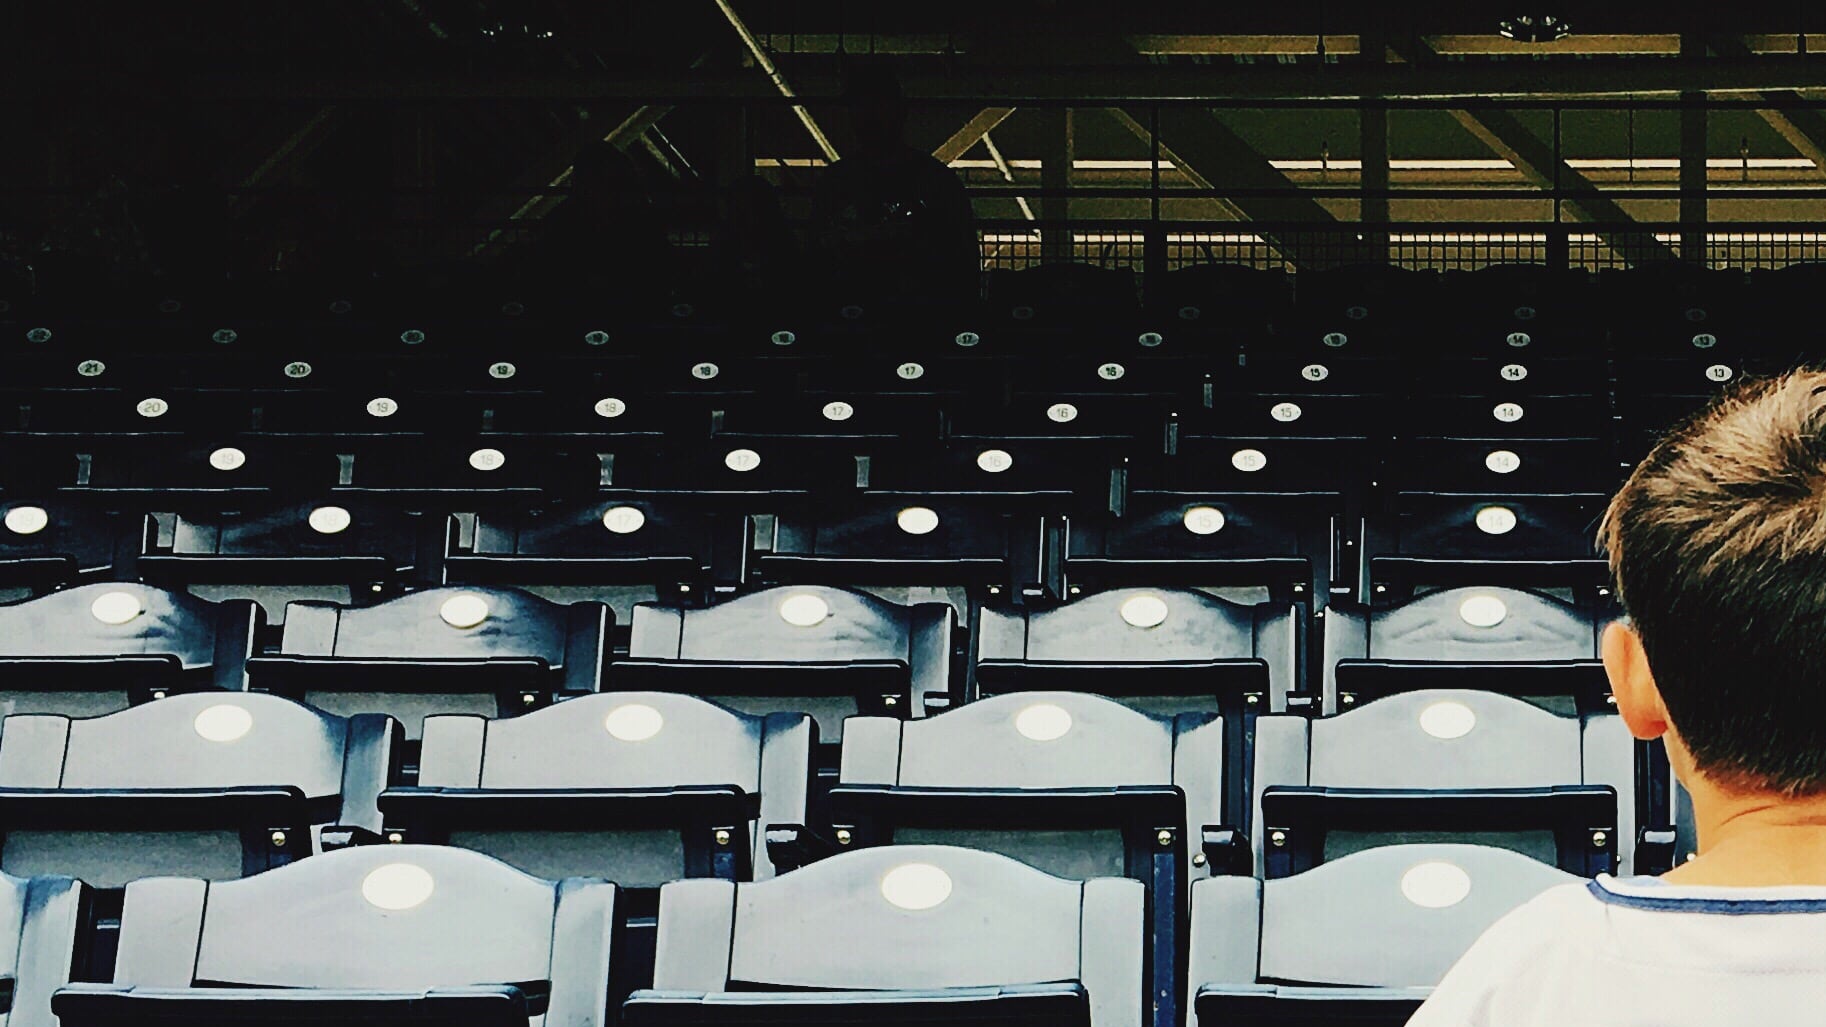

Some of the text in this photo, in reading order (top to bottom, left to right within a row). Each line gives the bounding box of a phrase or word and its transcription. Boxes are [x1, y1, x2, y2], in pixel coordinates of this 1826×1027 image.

[84, 363, 98, 373] 21
[290, 365, 306, 375] 20
[700, 366, 711, 376] 18
[905, 366, 916, 375] 17
[1105, 366, 1117, 377] 16
[1508, 368, 1519, 377] 14
[1714, 368, 1724, 378] 13
[143, 402, 161, 413] 20
[376, 402, 388, 413] 19
[604, 402, 616, 413] 18
[832, 406, 844, 416] 17
[1280, 407, 1292, 418] 15
[1503, 408, 1514, 417] 14
[1057, 408, 1068, 418] 16
[617, 513, 632, 526] 17
